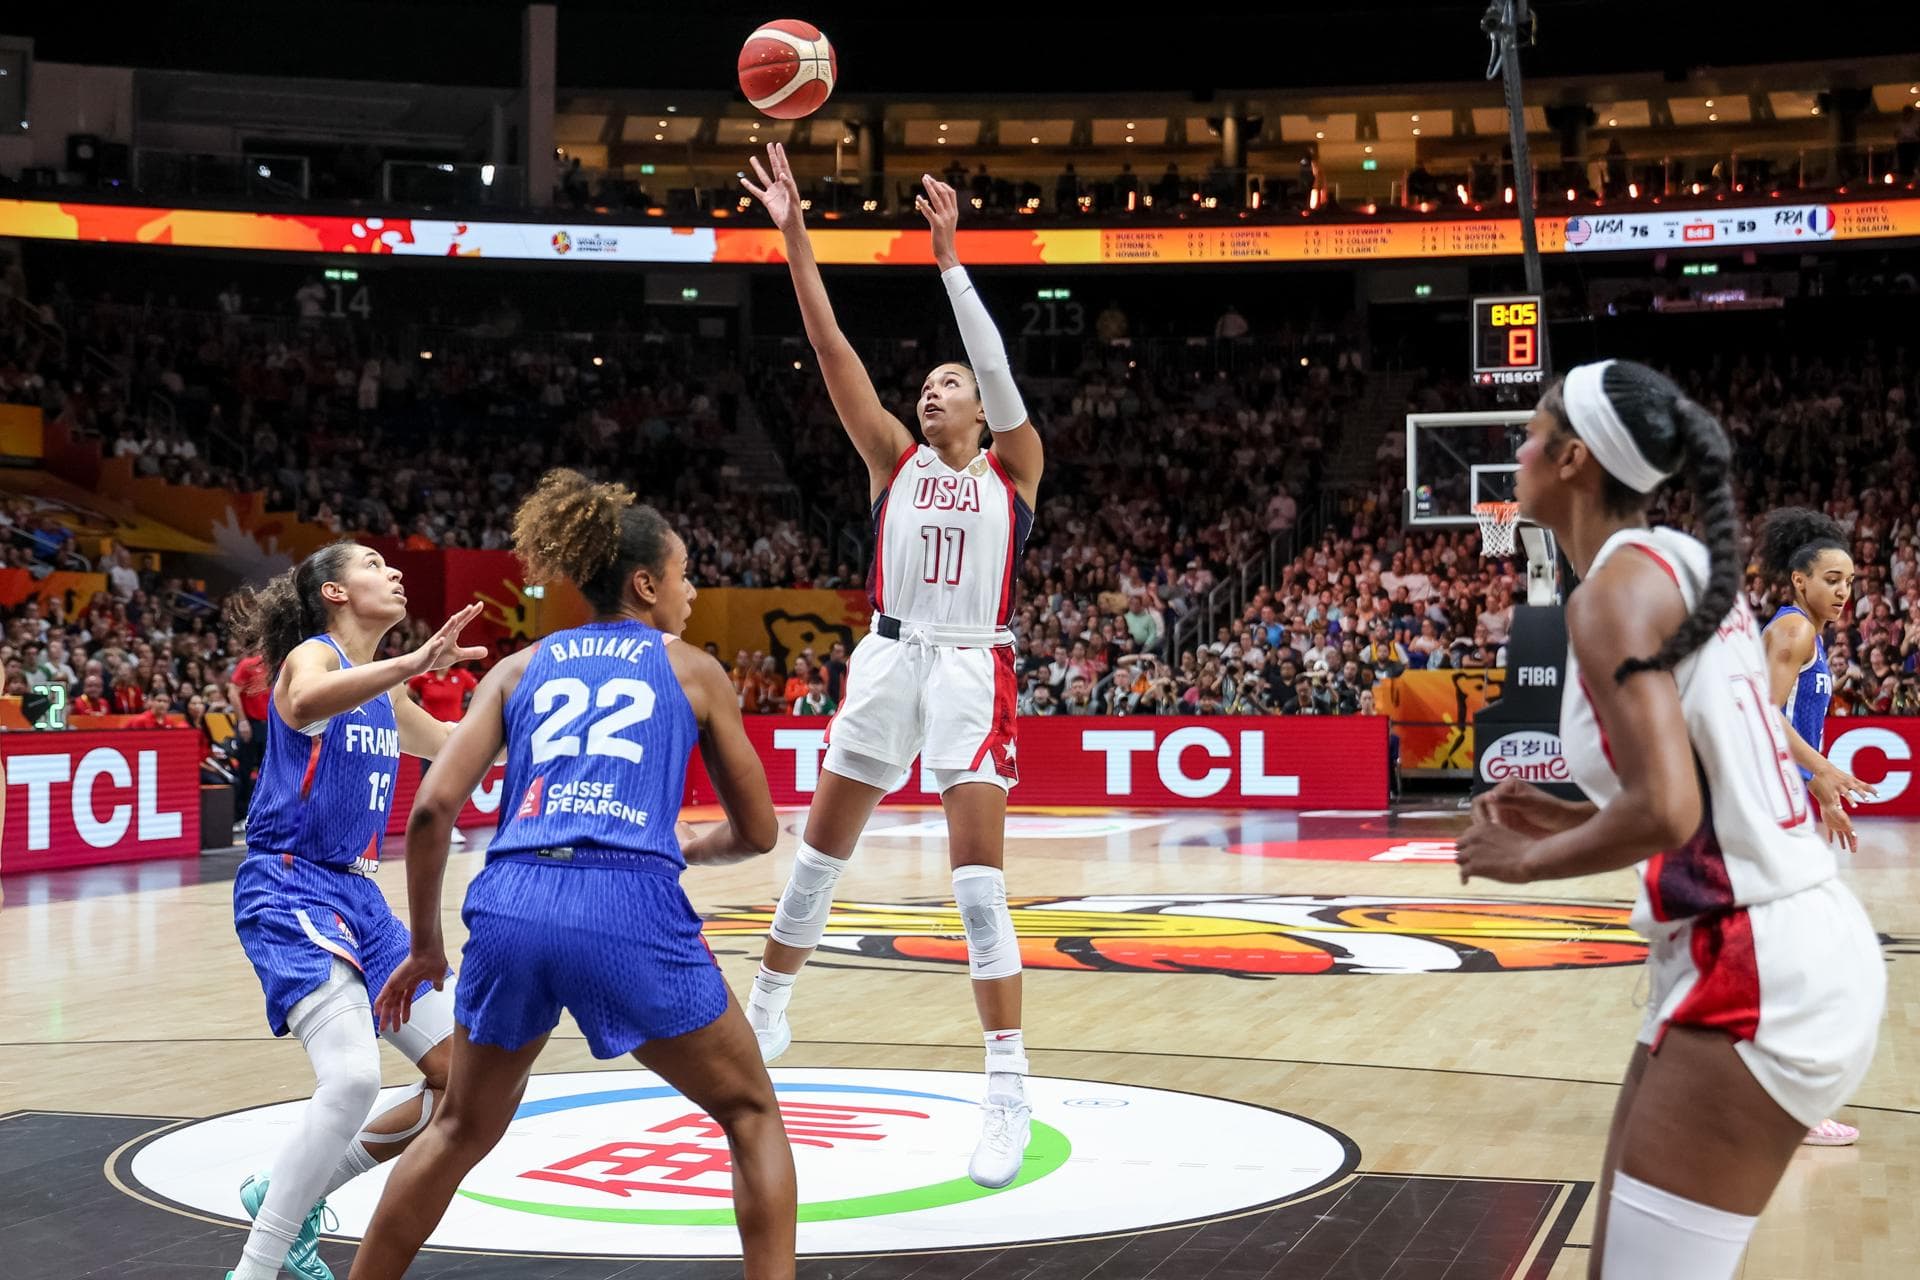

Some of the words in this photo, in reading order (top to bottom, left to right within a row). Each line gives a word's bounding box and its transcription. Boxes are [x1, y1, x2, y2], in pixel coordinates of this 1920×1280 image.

[1595, 218, 1624, 234] USA
[1630, 226, 1648, 238] 76
[1736, 220, 1756, 233] 59
[1775, 210, 1802, 226] FRA
[1021, 302, 1085, 336] 213
[1491, 303, 1537, 326] 8:05
[1508, 328, 1535, 365] 8
[1492, 371, 1544, 384] TISSOT
[912, 476, 980, 512] USA
[920, 525, 965, 585] 11
[550, 636, 652, 664] BADIANE
[1518, 666, 1557, 687] FIBA
[531, 678, 656, 764] 22
[1501, 740, 1561, 756] 百岁山
[1082, 726, 1299, 798] TCL
[7, 747, 182, 850] TCL
[548, 780, 615, 799] CAISSE
